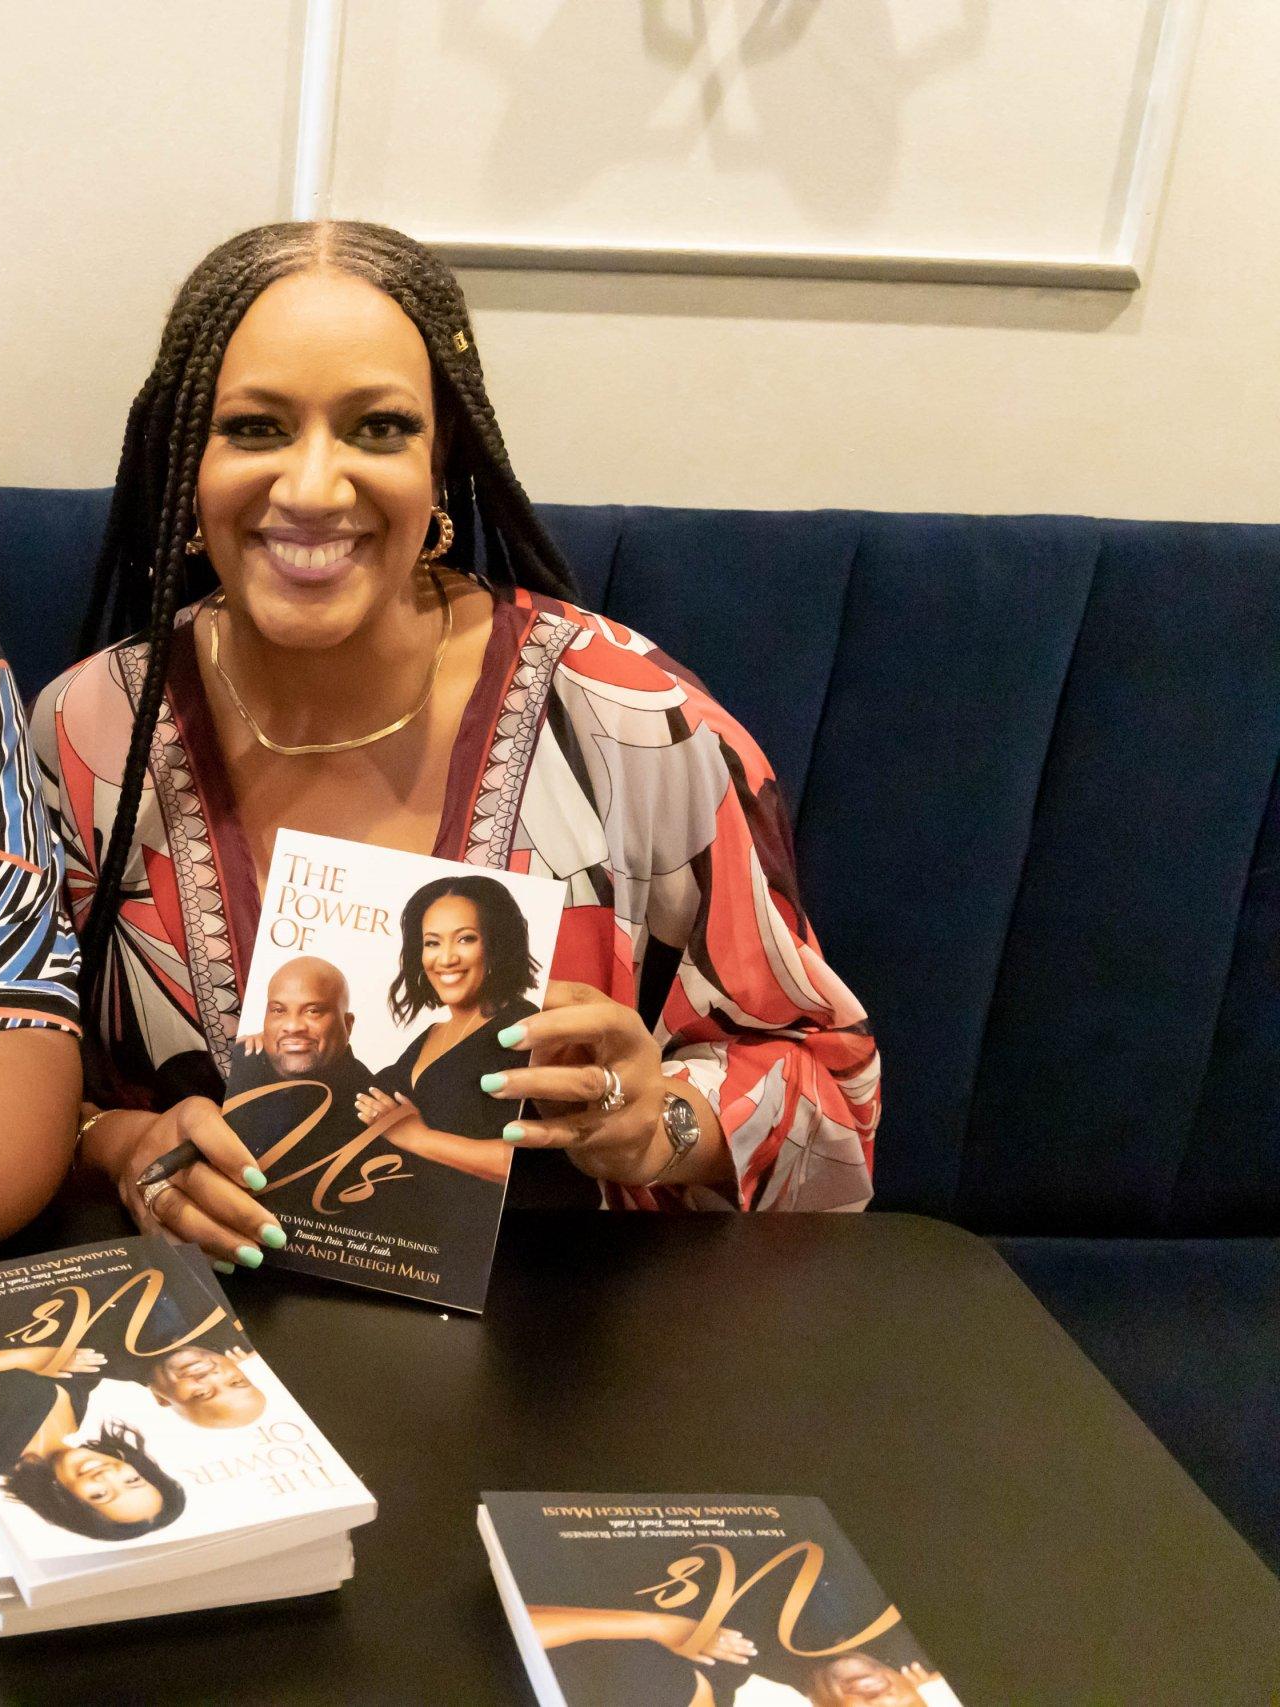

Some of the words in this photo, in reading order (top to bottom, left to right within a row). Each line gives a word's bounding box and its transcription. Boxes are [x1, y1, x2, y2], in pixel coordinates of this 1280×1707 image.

[284, 854, 346, 892] THE
[277, 886, 392, 936] POWER
[270, 918, 315, 951] OF
[222, 1080, 414, 1214] Us
[294, 1230, 322, 1242] Passion.
[324, 1236, 343, 1247] Pain.
[347, 1240, 368, 1252] Truth.
[369, 1246, 392, 1257] Faith.
[328, 1224, 372, 1241] MARRIAGE
[340, 1250, 396, 1275] LESLEIGH
[398, 1262, 440, 1285] MAUSI
[5, 1268, 227, 1374] Us
[258, 1422, 304, 1445] OF
[182, 1443, 324, 1485] POWER
[266, 1466, 348, 1495] THE
[634, 1541, 901, 1658] Us
